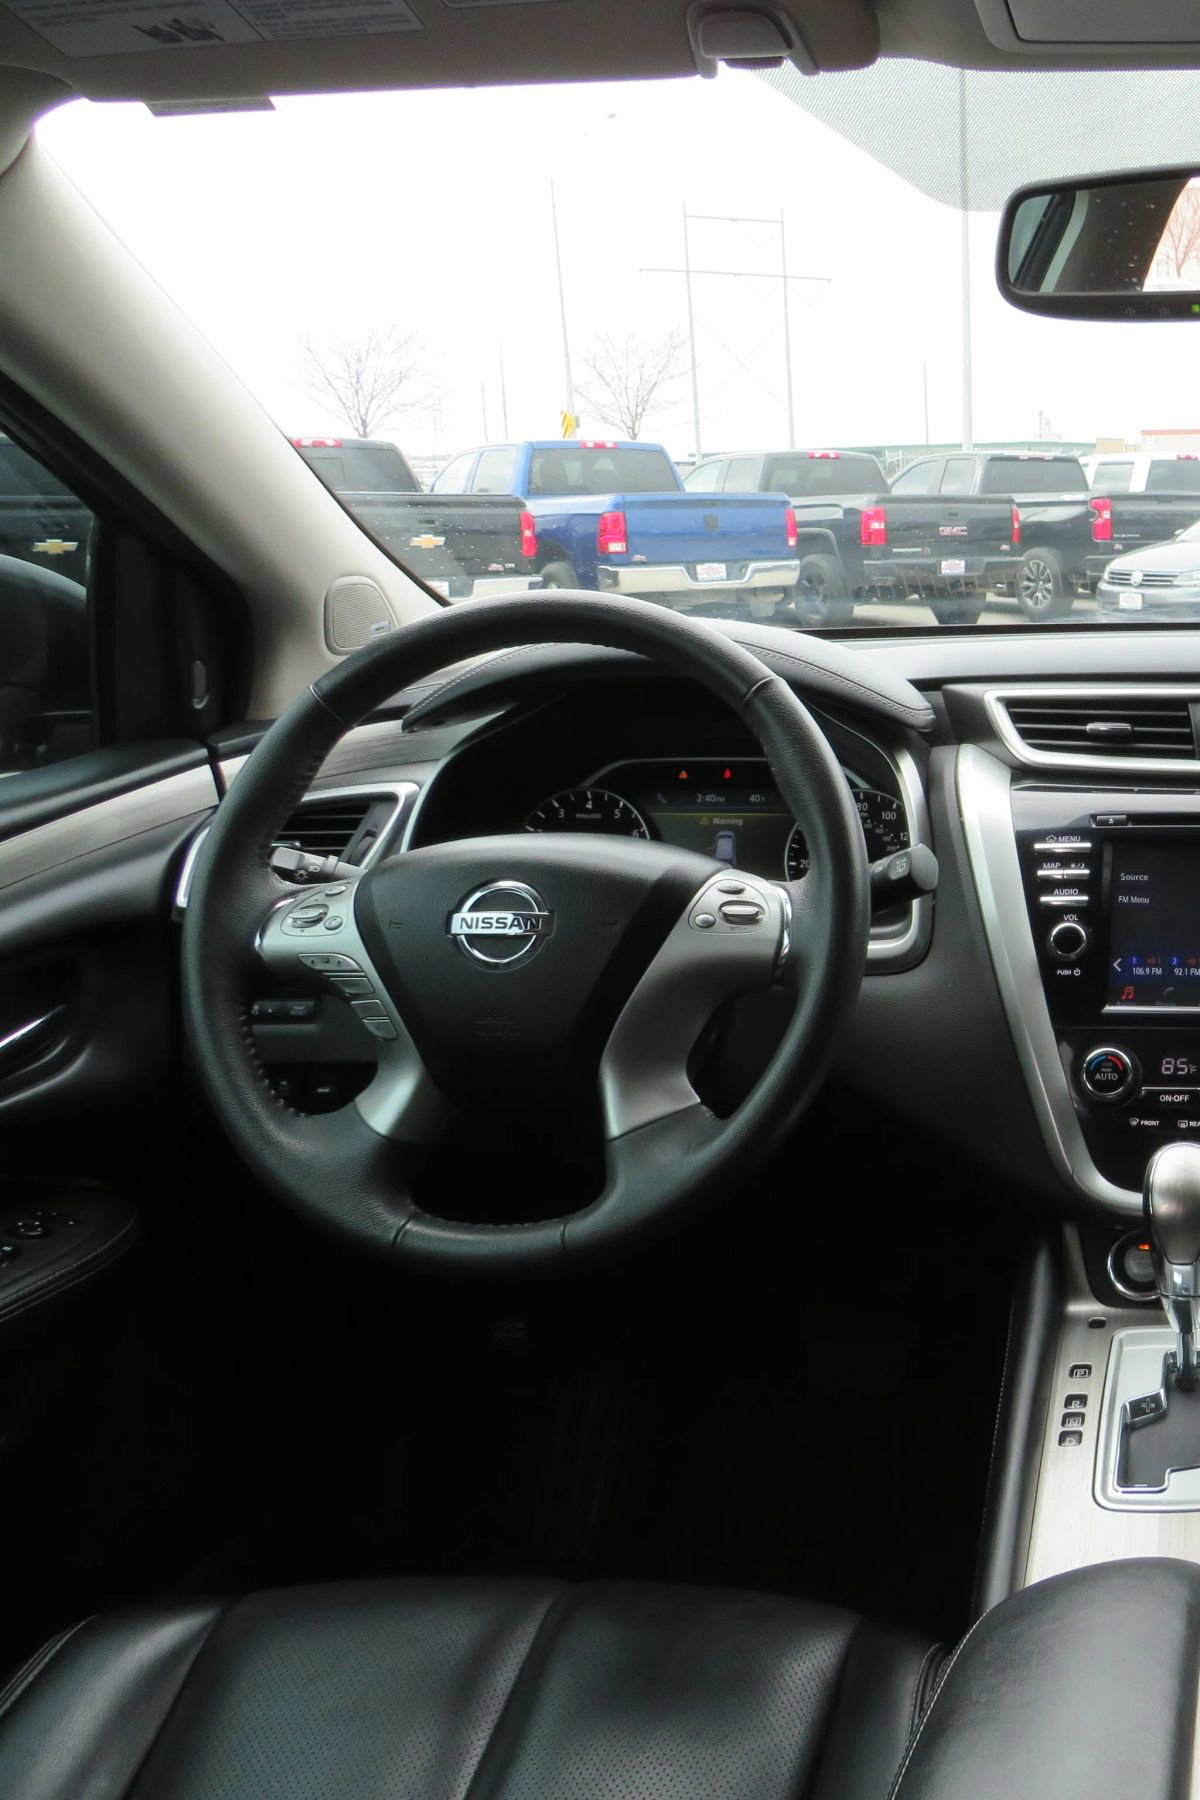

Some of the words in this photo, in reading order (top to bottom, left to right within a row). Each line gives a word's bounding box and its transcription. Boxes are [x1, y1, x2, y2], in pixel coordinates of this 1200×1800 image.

[586, 800, 593, 809] 4
[558, 809, 565, 818] 3
[614, 809, 621, 819] 5
[881, 811, 897, 820] 100
[713, 816, 743, 826] Warning
[900, 832, 909, 841] 12
[1058, 835, 1081, 843] MENU
[1120, 872, 1149, 881] Source
[1053, 888, 1079, 896] AUDIO
[1130, 895, 1150, 904] Menu
[459, 916, 542, 931] NISSAN
[1132, 967, 1150, 975] 106.9
[1151, 967, 1162, 975] FM
[1174, 968, 1188, 976] 92.1
[1190, 968, 1200, 976] FM
[1094, 1073, 1119, 1081] AUTO
[1140, 1119, 1160, 1127] FRONT
